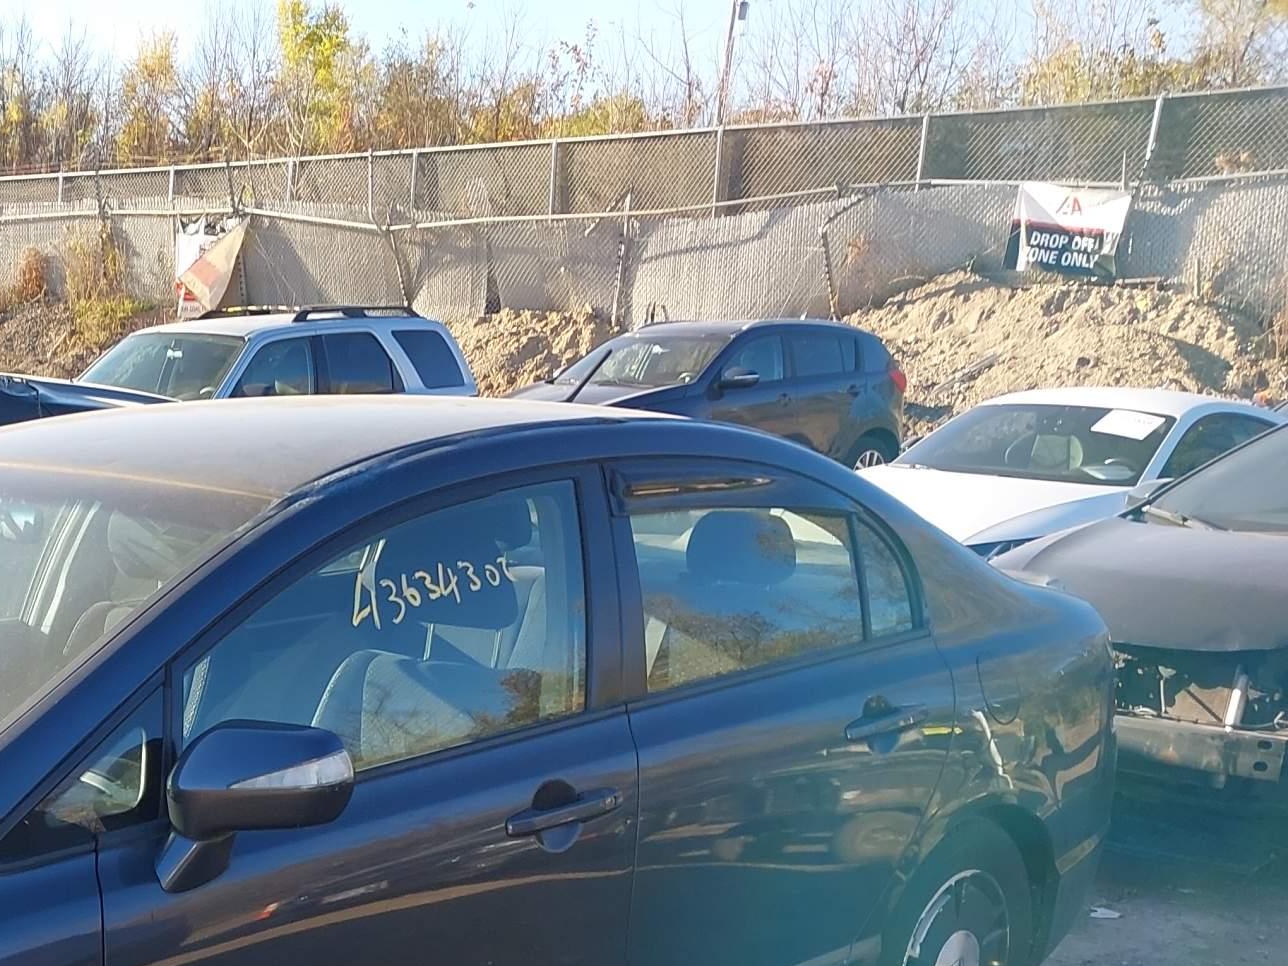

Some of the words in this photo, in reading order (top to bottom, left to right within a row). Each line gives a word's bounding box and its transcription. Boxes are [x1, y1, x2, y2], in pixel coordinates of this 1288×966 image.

[1030, 230, 1069, 249] DROP
[1072, 235, 1096, 253] OFF
[1061, 251, 1100, 269] ONLY
